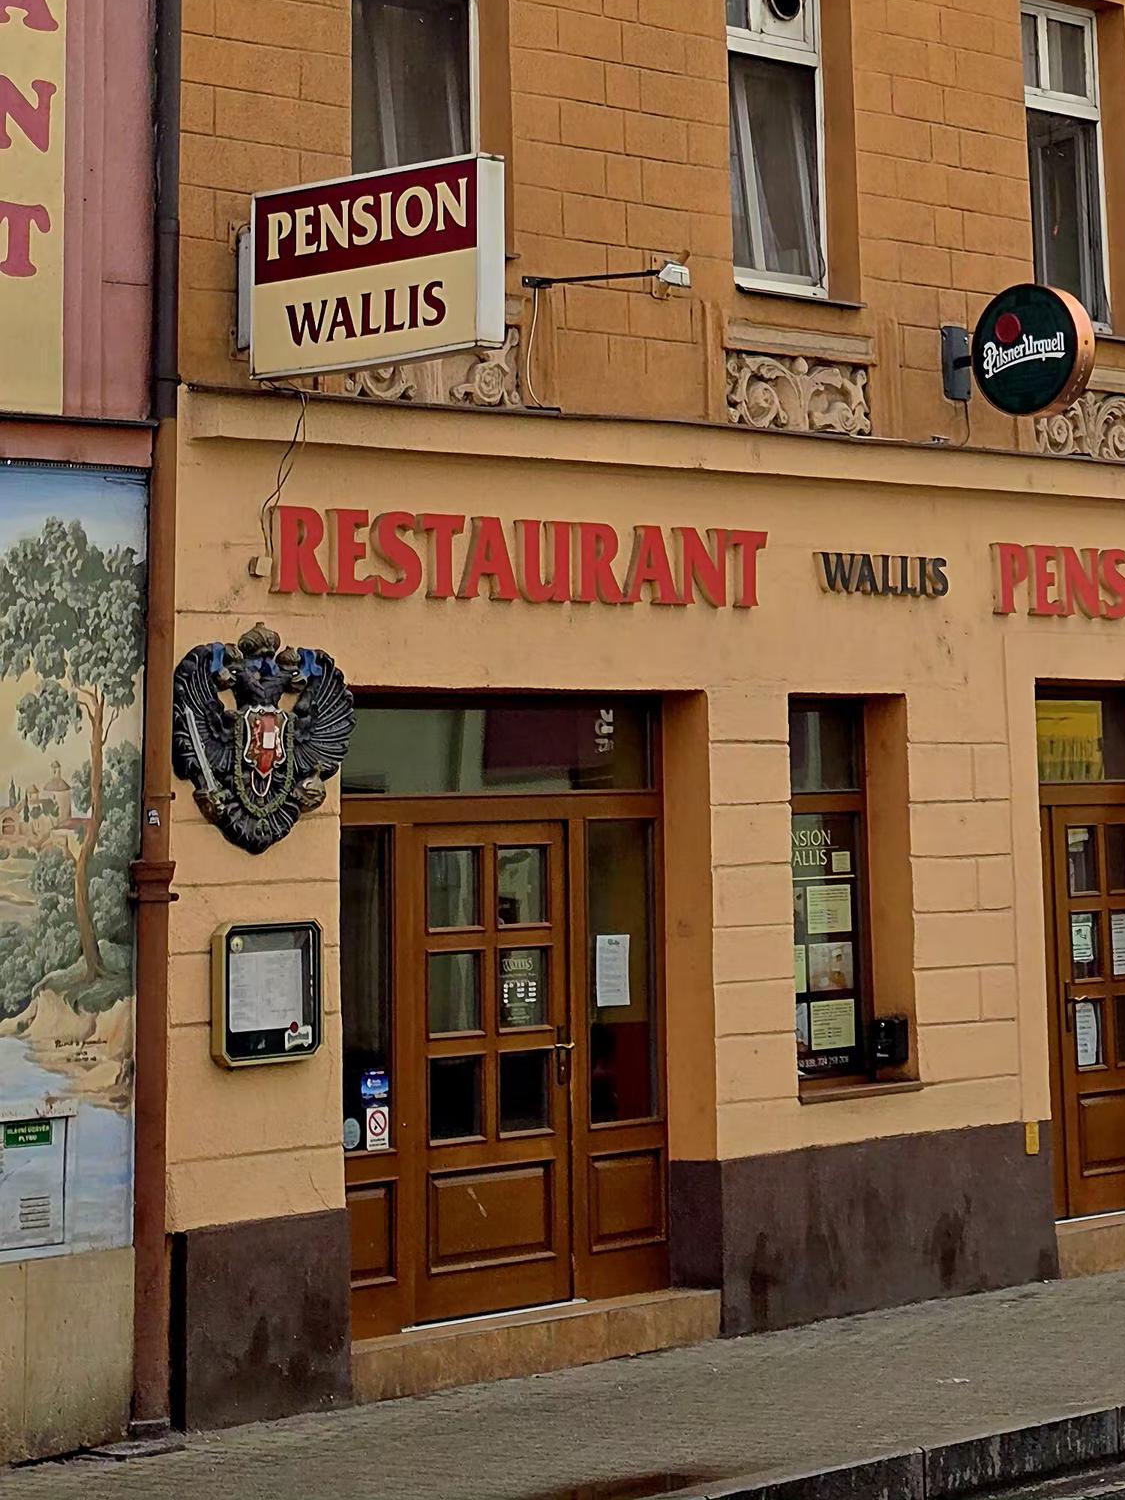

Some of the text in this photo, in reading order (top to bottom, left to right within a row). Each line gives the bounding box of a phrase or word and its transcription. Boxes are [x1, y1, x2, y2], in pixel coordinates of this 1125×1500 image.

[266, 177, 468, 261] PENSION
[285, 280, 447, 347] WALLIS
[983, 331, 1066, 379] Pilsner Urquell
[269, 506, 768, 608] RESTAURANT
[817, 552, 948, 597] WALLIS
[790, 829, 831, 846] NSION
[792, 849, 828, 866] ALLIS
